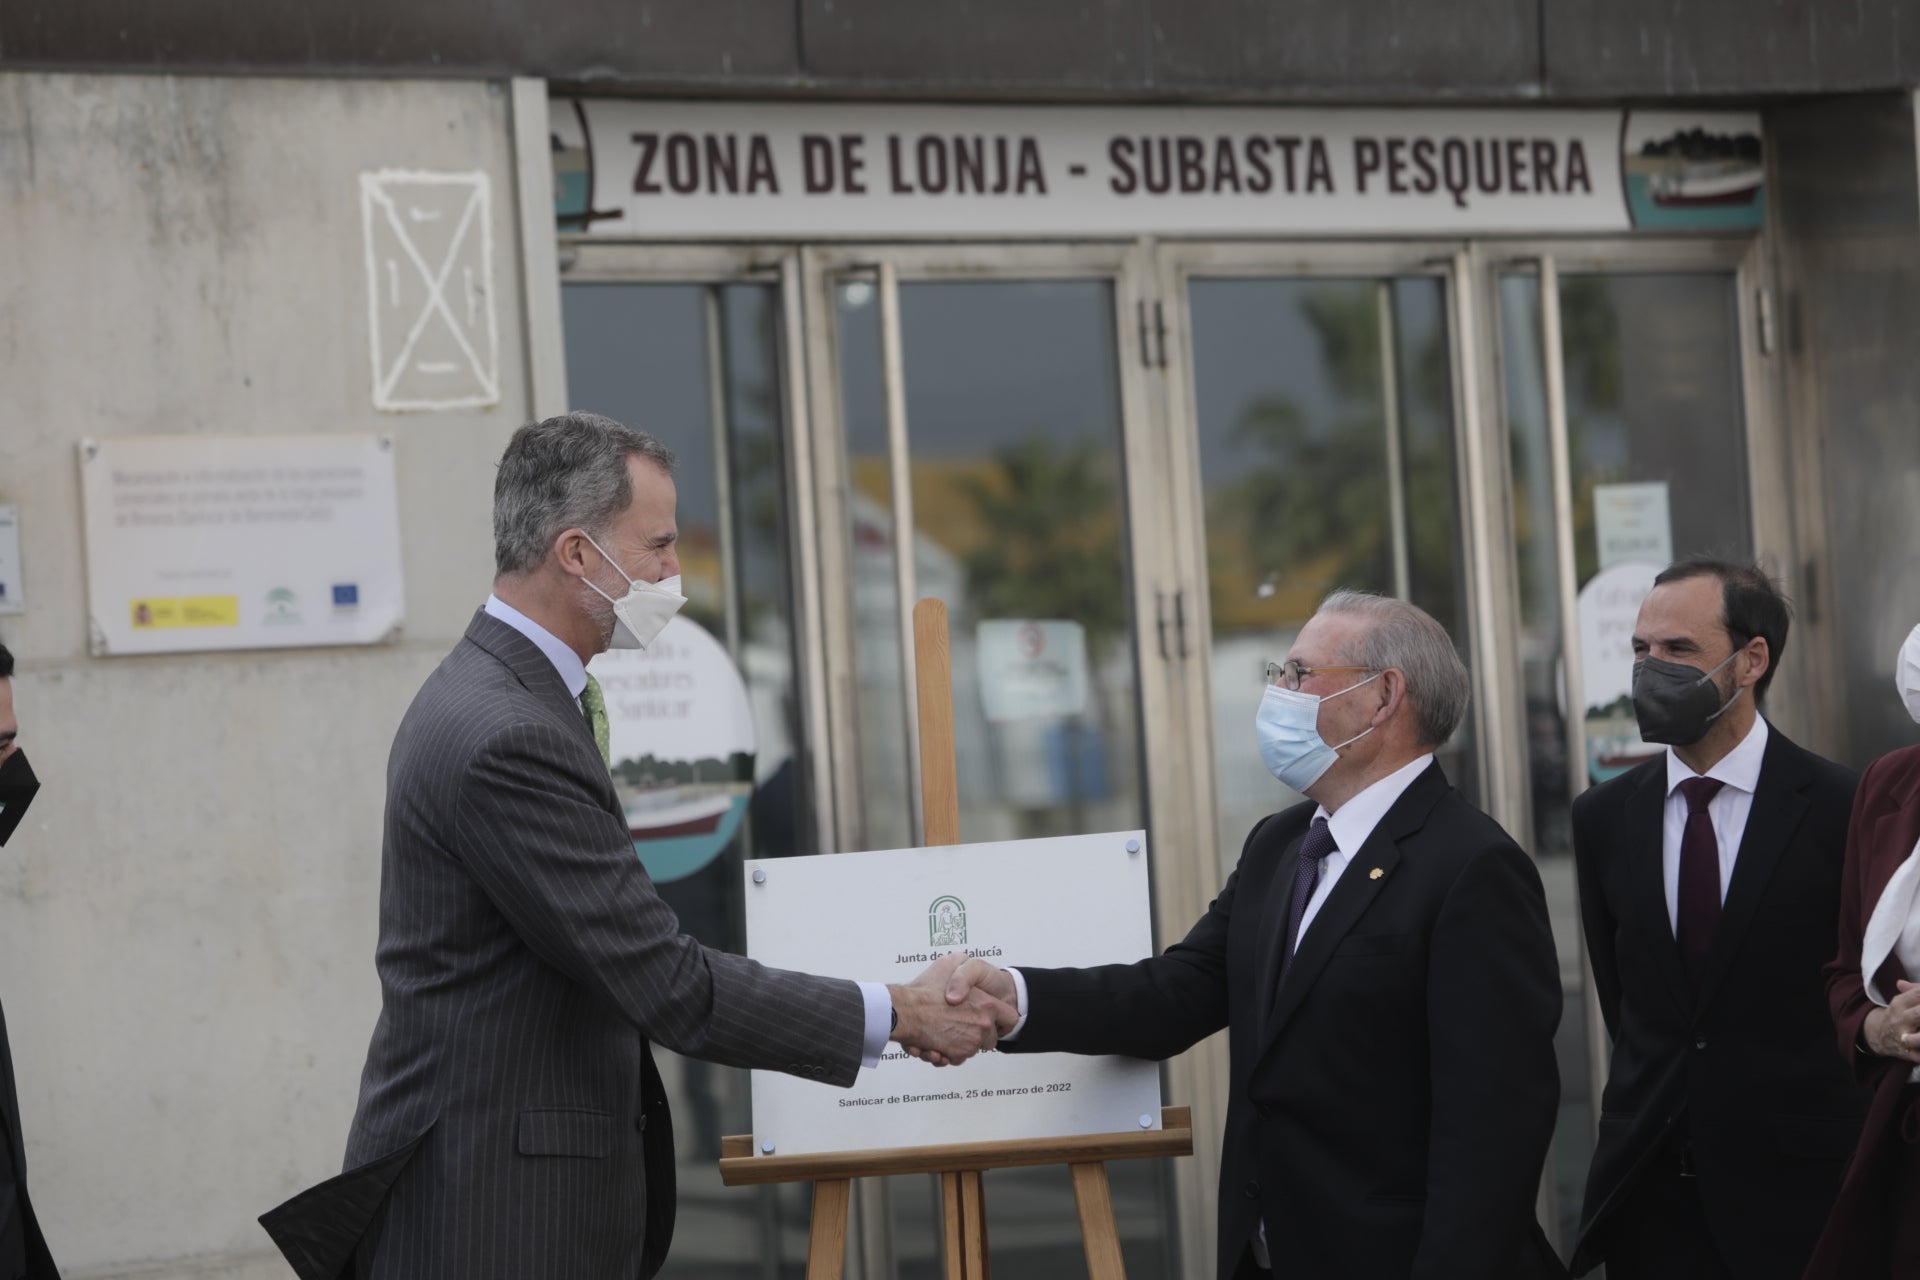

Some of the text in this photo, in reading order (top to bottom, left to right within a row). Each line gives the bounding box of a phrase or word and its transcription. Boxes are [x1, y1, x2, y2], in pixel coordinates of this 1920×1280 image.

[631, 133, 1592, 210] ZONA DE LONJA - SUBASTA PESQUERA
[895, 951, 928, 963] Junta
[947, 945, 1002, 959] alucía
[880, 1050, 910, 1061] nario
[838, 1082, 1072, 1107] Sanlúcar de Barrameda, 25 de marzo de 2022
